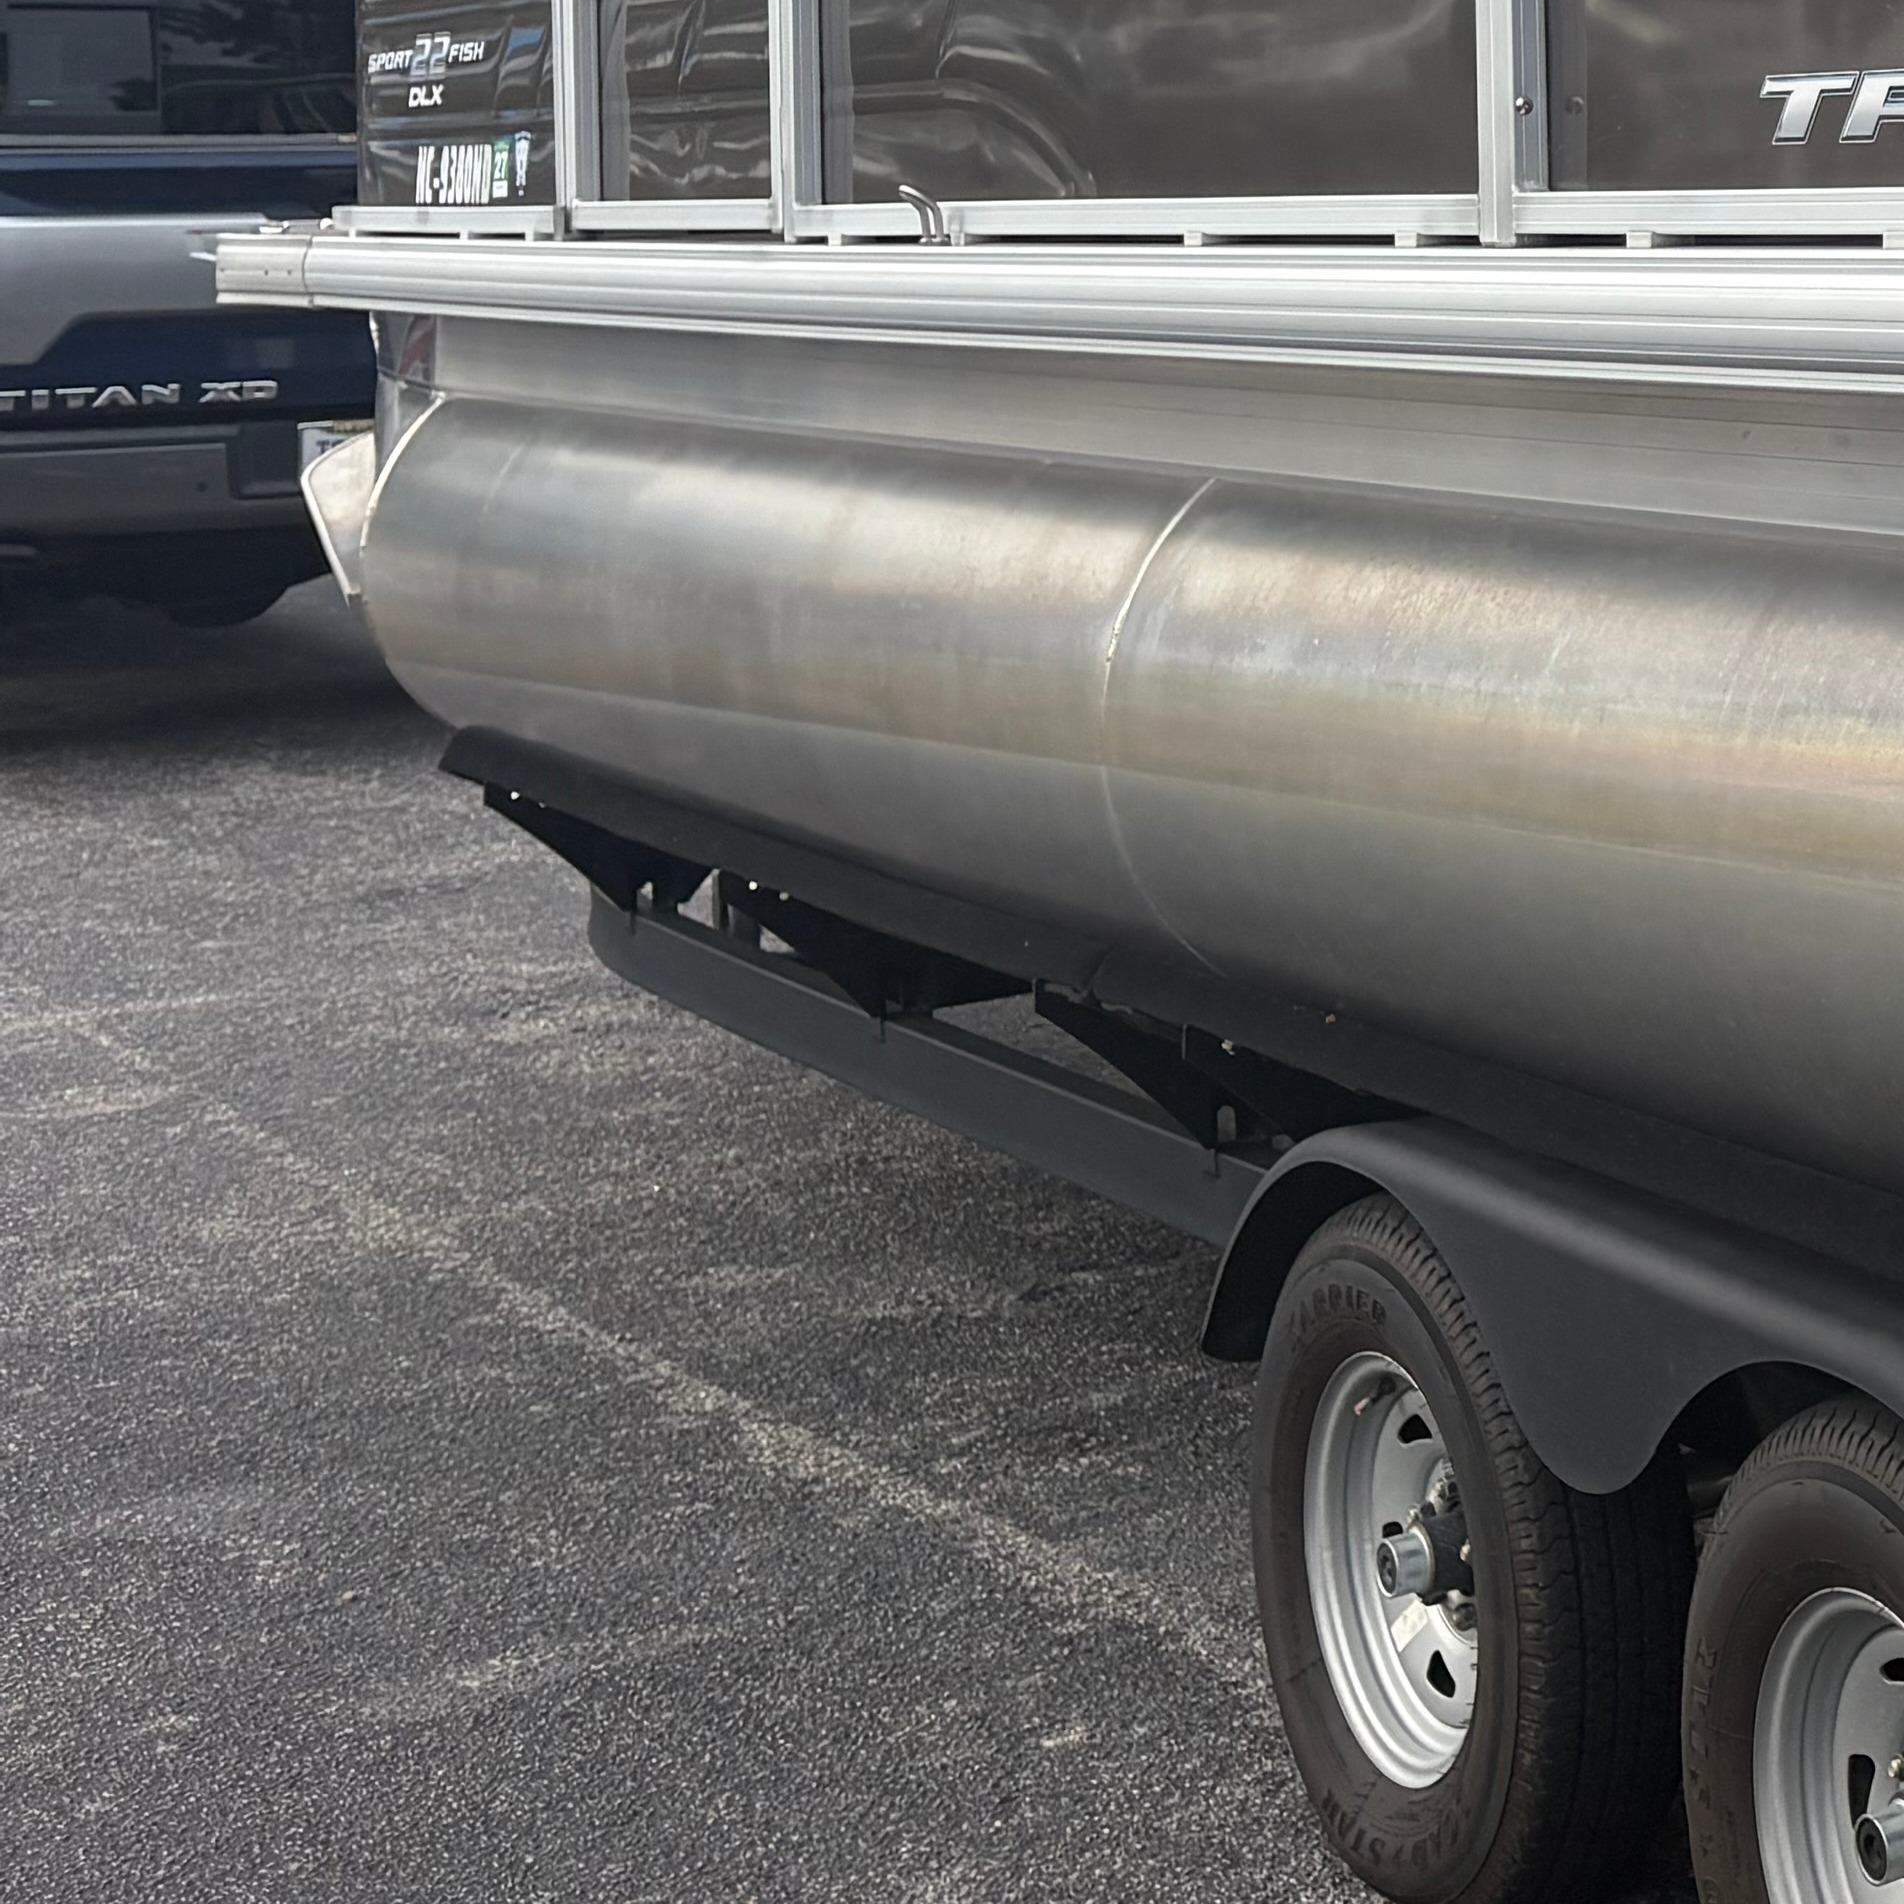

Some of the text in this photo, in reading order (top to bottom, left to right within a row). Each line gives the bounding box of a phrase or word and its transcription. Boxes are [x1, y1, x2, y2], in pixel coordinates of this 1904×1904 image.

[368, 31, 485, 82] SPORT 22 FISH
[408, 84, 444, 108] DLX
[0, 379, 279, 412] TITAN XD
